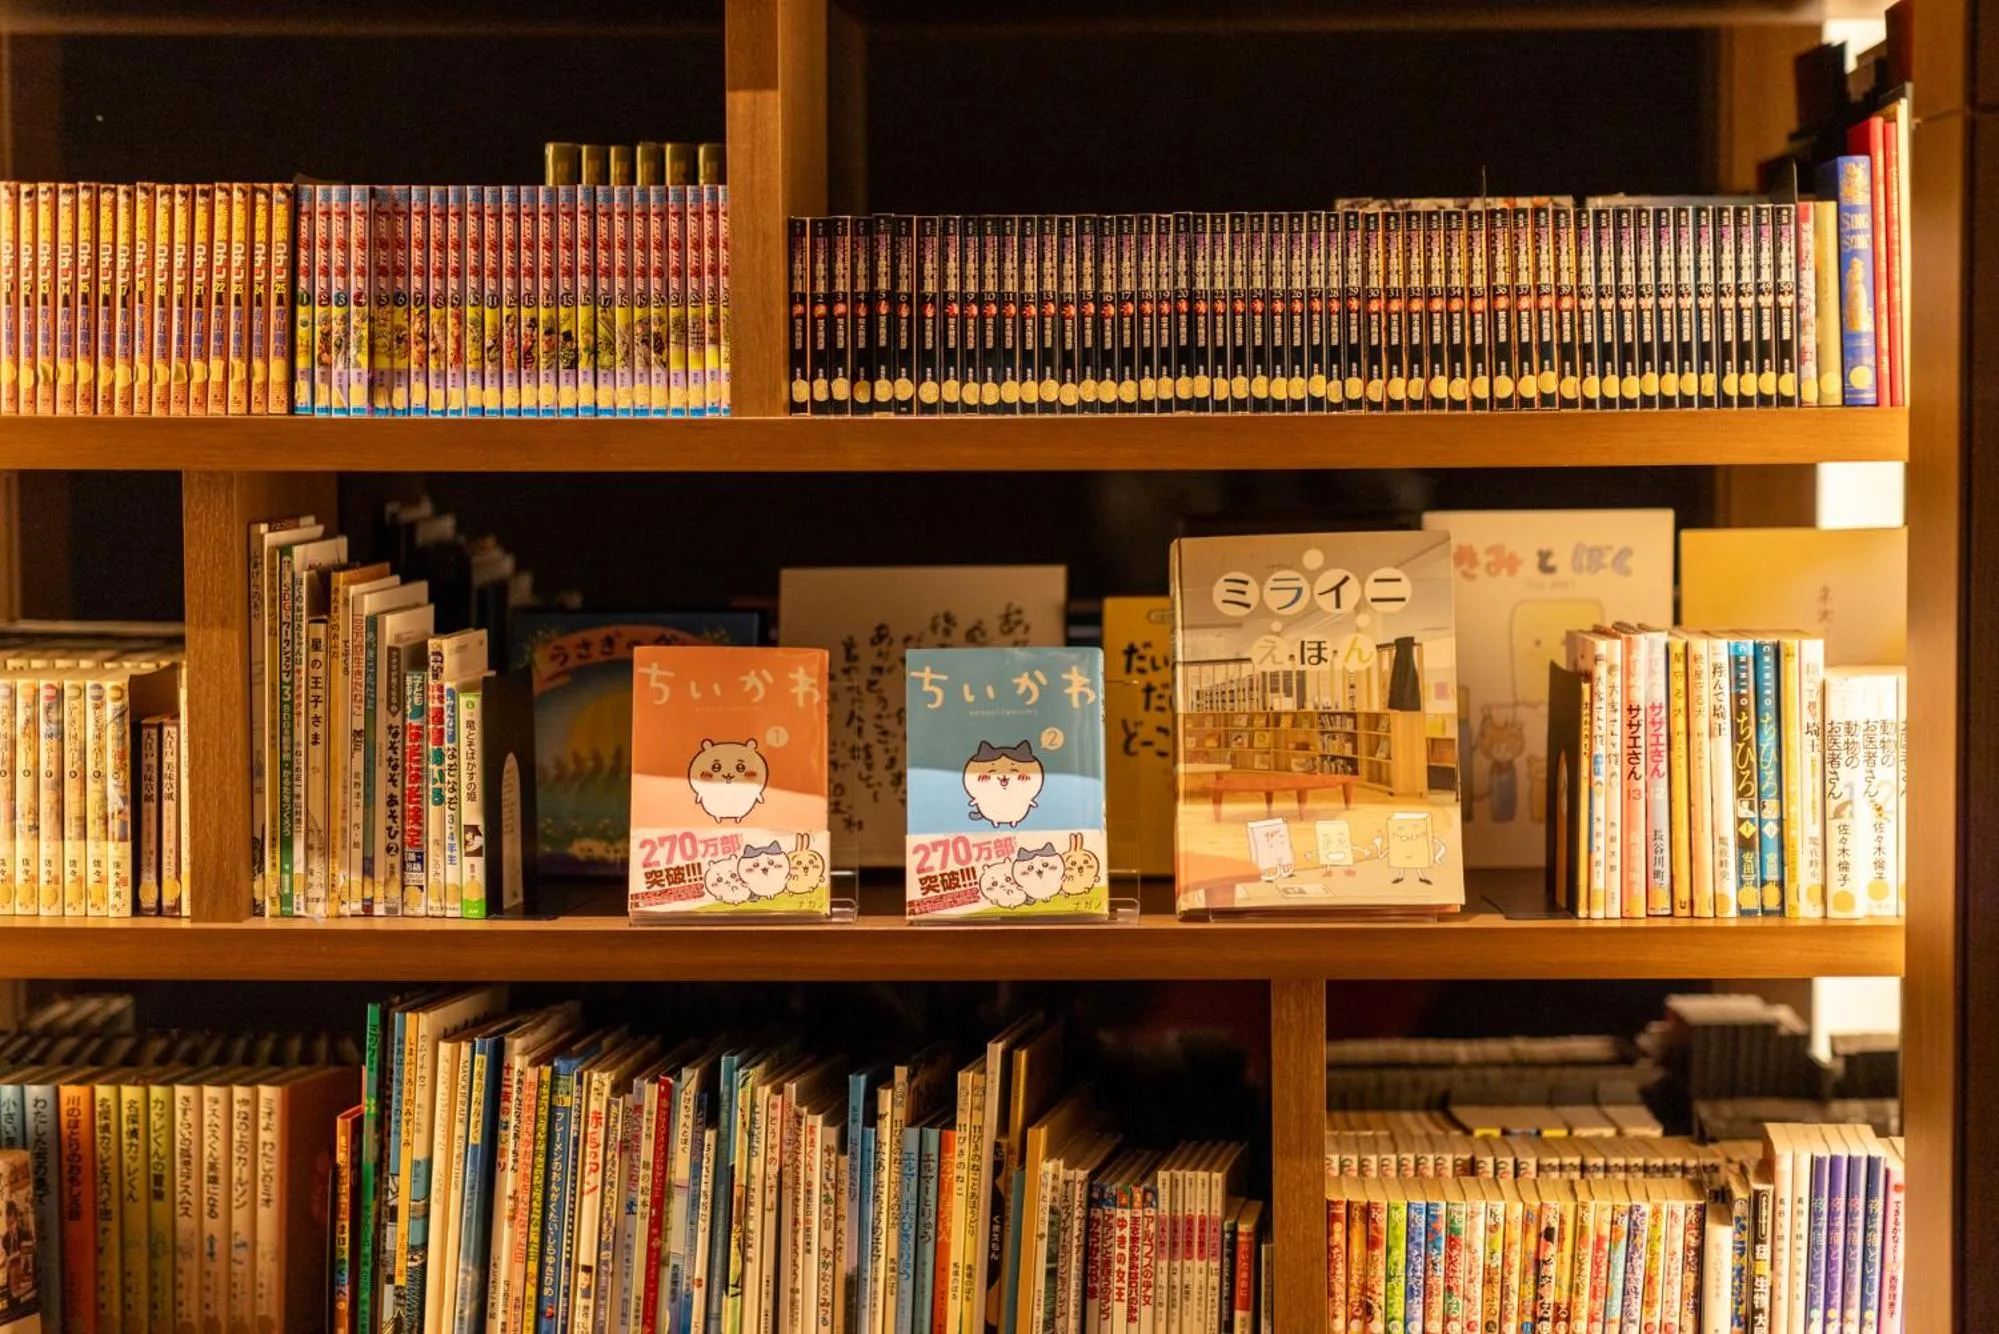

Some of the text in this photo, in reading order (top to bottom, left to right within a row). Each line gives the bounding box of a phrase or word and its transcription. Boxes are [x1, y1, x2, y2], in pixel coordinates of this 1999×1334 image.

[796, 293, 800, 301] 1
[818, 294, 824, 302] 2
[858, 293, 864, 301] 4
[880, 291, 886, 299] 5
[901, 293, 907, 301] 6
[926, 293, 932, 301] 7
[1024, 294, 1035, 302] 12
[1221, 575, 1406, 609] ミライニ
[311, 638, 323, 746] 星の王子さま
[638, 662, 821, 708] ちいかわ
[911, 665, 1096, 708] ちいかわ
[465, 719, 477, 802] 竜とそばかすの姫
[1626, 703, 1643, 800] サザエさん 13
[1649, 702, 1666, 778] サザエさん
[1735, 711, 1756, 797] ちひろ
[1759, 713, 1778, 797] ちひろ
[1827, 719, 1843, 800] お医者さん
[1844, 720, 1860, 769] 動物の
[1863, 719, 1880, 798] お医者さん
[1879, 720, 1896, 768] 動物の
[446, 747, 458, 811] なぞなぞ
[639, 831, 742, 871] 270万部
[643, 861, 703, 888] 突破!!!
[912, 832, 1015, 874] 270万部
[1837, 822, 1852, 887] 佐々木倫子
[918, 866, 979, 896] 突破!!!
[955, 1122, 967, 1197] 11ぴきのねこ
[919, 1151, 935, 1243] エルマーとりゅう
[1115, 1217, 1129, 1303] ゆきの女王
[1141, 1214, 1155, 1307] アルプスの少女
